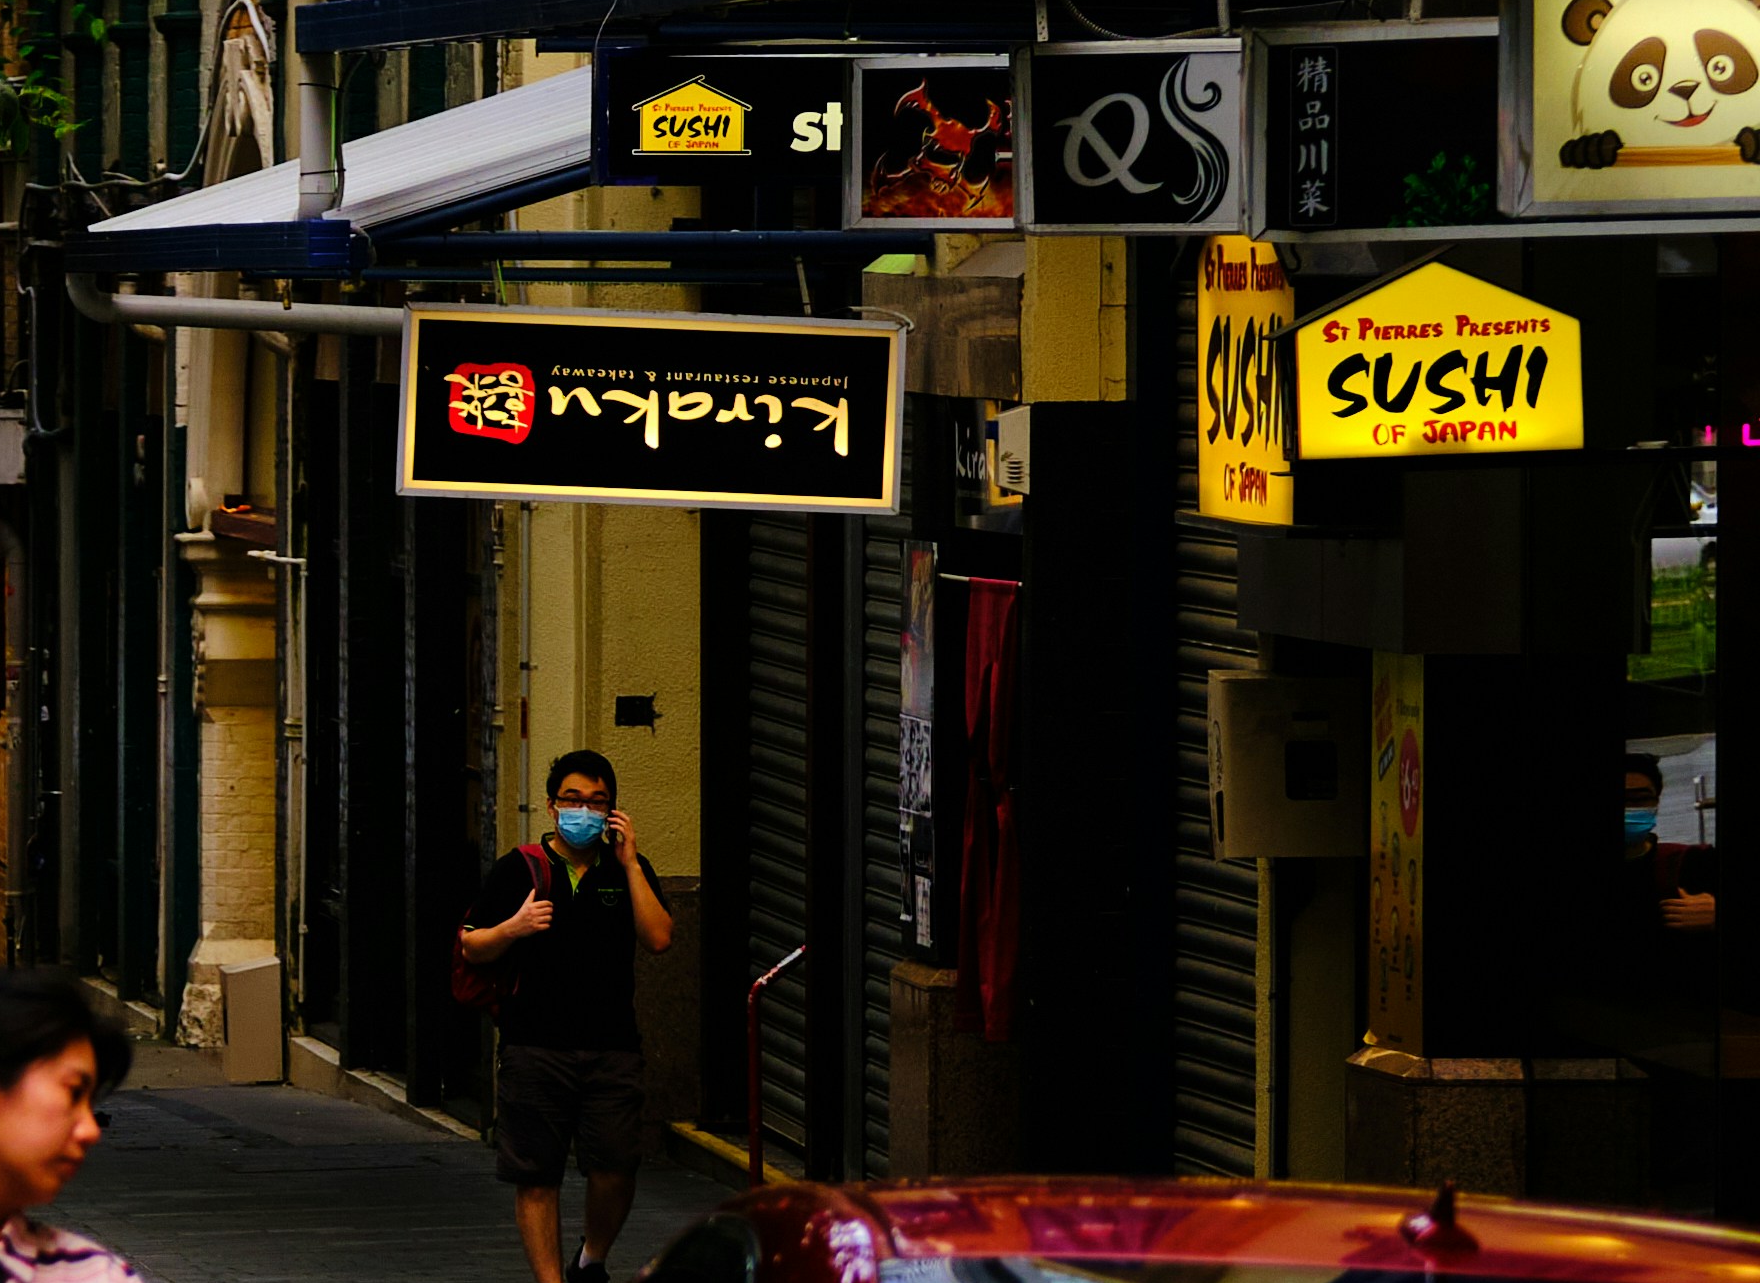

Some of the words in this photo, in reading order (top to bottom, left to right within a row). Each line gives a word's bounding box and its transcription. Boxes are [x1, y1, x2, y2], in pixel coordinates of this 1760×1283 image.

[653, 114, 731, 138] SUSHI
[1296, 55, 1332, 218] 精品川菜
[1358, 318, 1443, 342] PIERRES
[1456, 314, 1551, 338] PRESENTS
[550, 364, 634, 380] takeaway
[644, 369, 657, 382] &
[665, 371, 759, 385] restaurant
[768, 374, 849, 391] Japanese
[1207, 313, 1283, 451] SUSHI
[1327, 343, 1549, 418] SUSHI
[547, 385, 850, 458] kiraku
[1373, 422, 1405, 445] OF
[1422, 419, 1518, 444] JAPAN
[954, 420, 987, 482] kira
[1238, 462, 1268, 506] JAPAN
